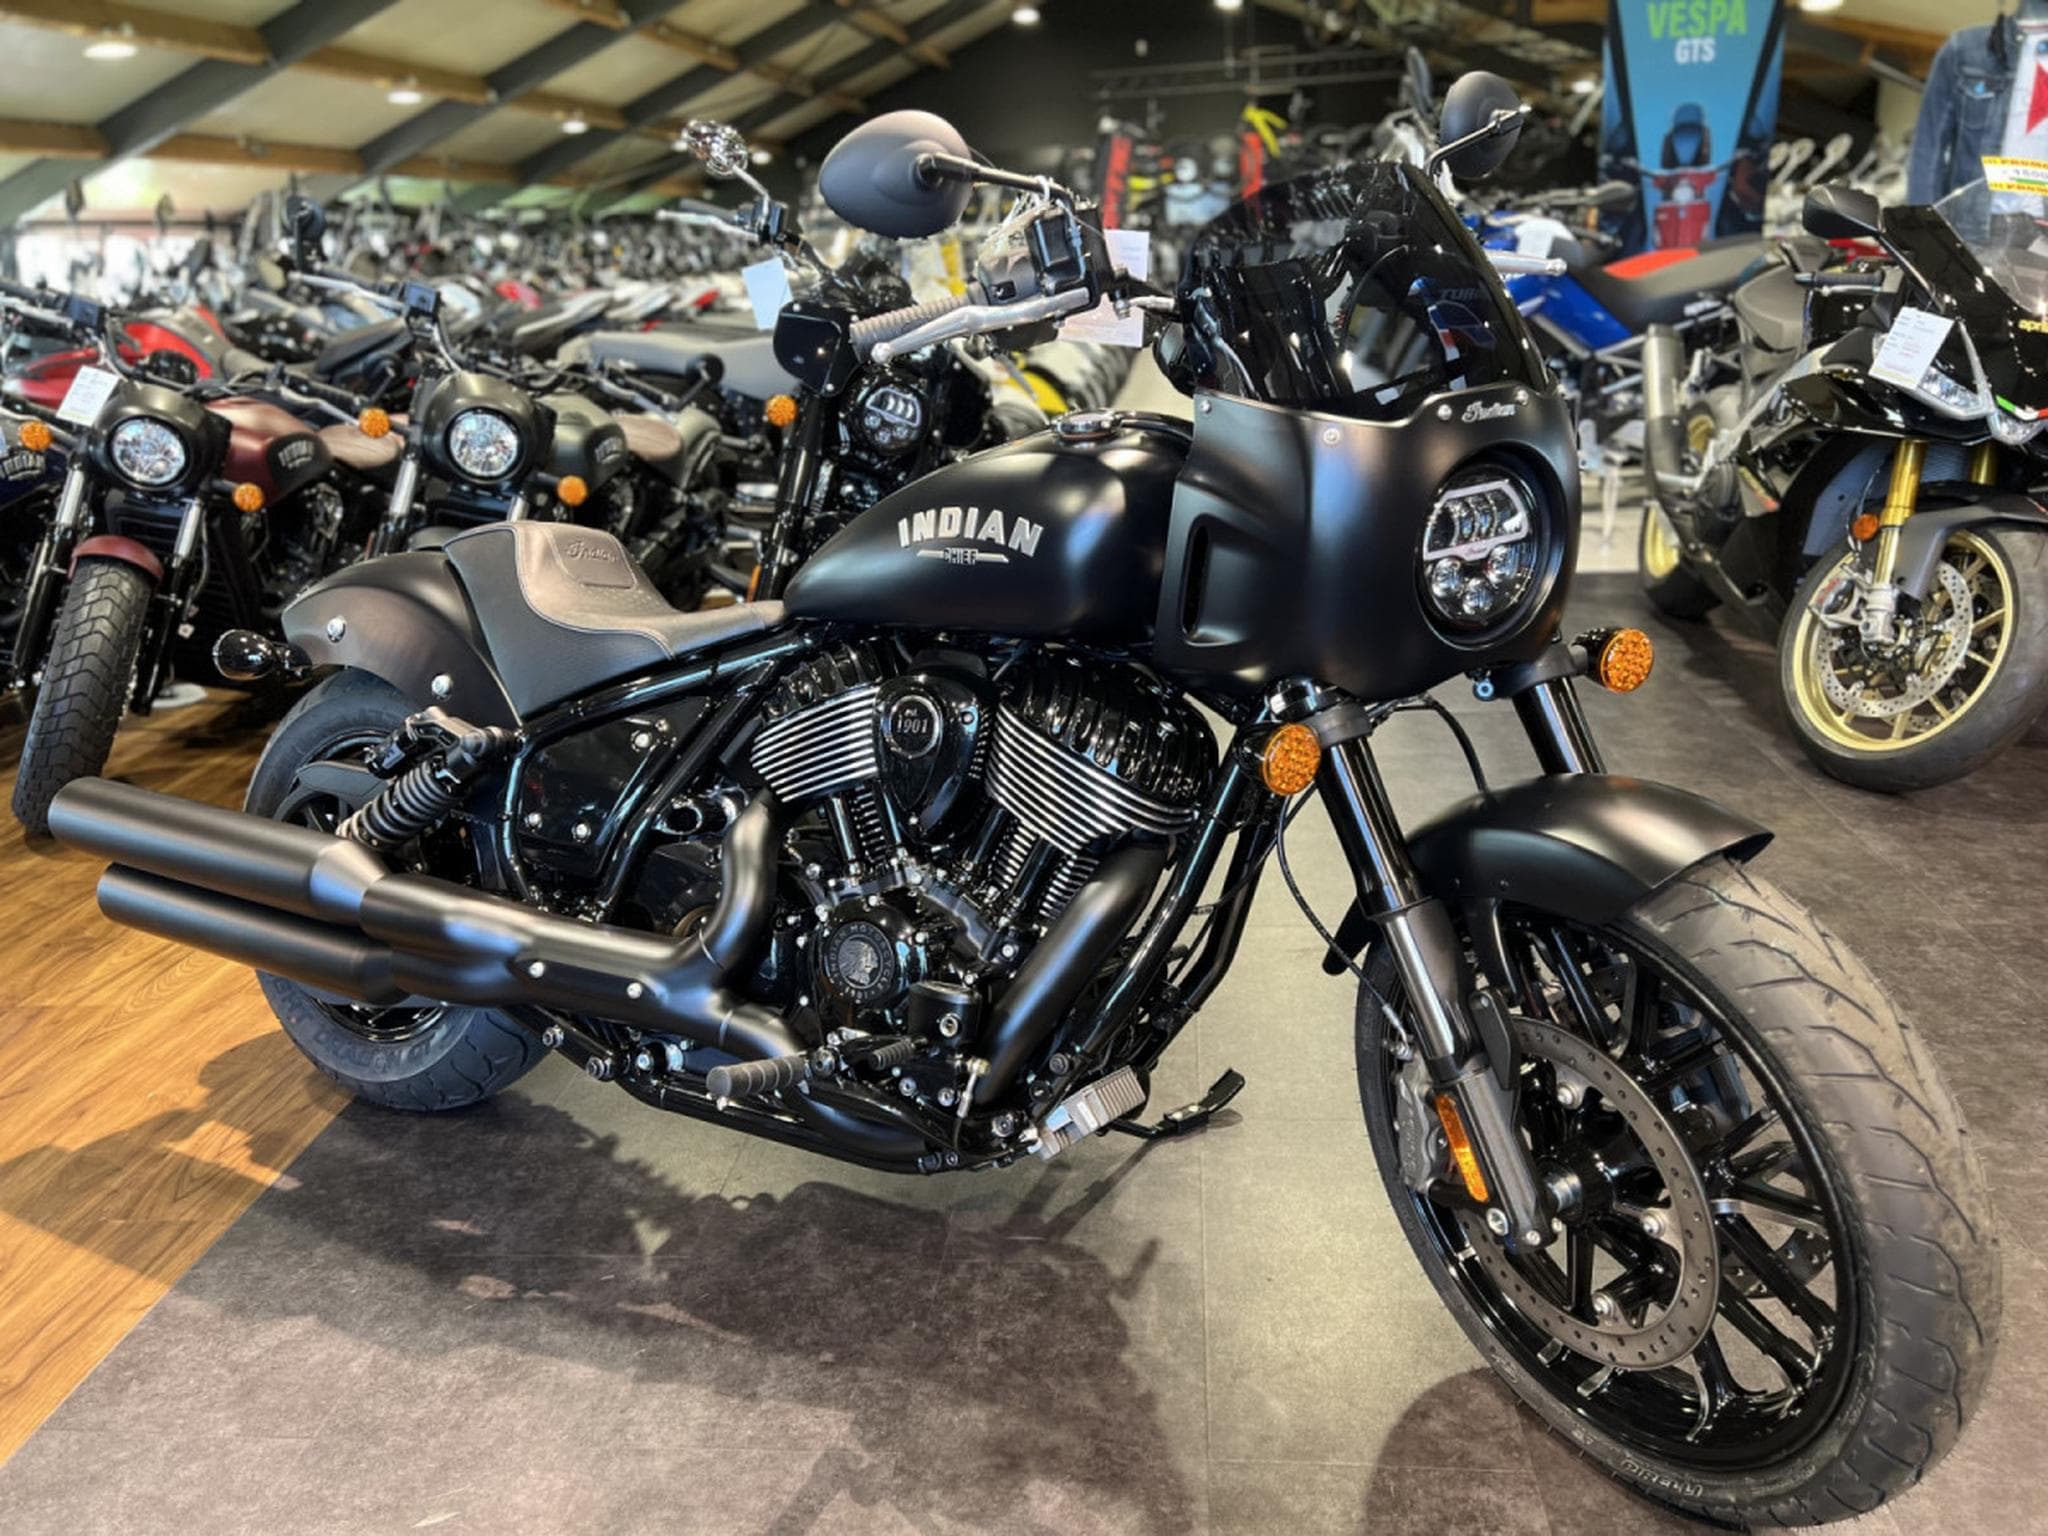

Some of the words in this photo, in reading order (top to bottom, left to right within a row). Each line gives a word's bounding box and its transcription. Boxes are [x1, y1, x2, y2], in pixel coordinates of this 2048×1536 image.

[1647, 0, 1748, 39] VESPA
[1675, 37, 1716, 64] GTS
[1462, 401, 1516, 423] Indian
[897, 506, 1045, 558] INDIAN
[943, 547, 978, 565] CHIEF
[896, 714, 928, 733] 1901
